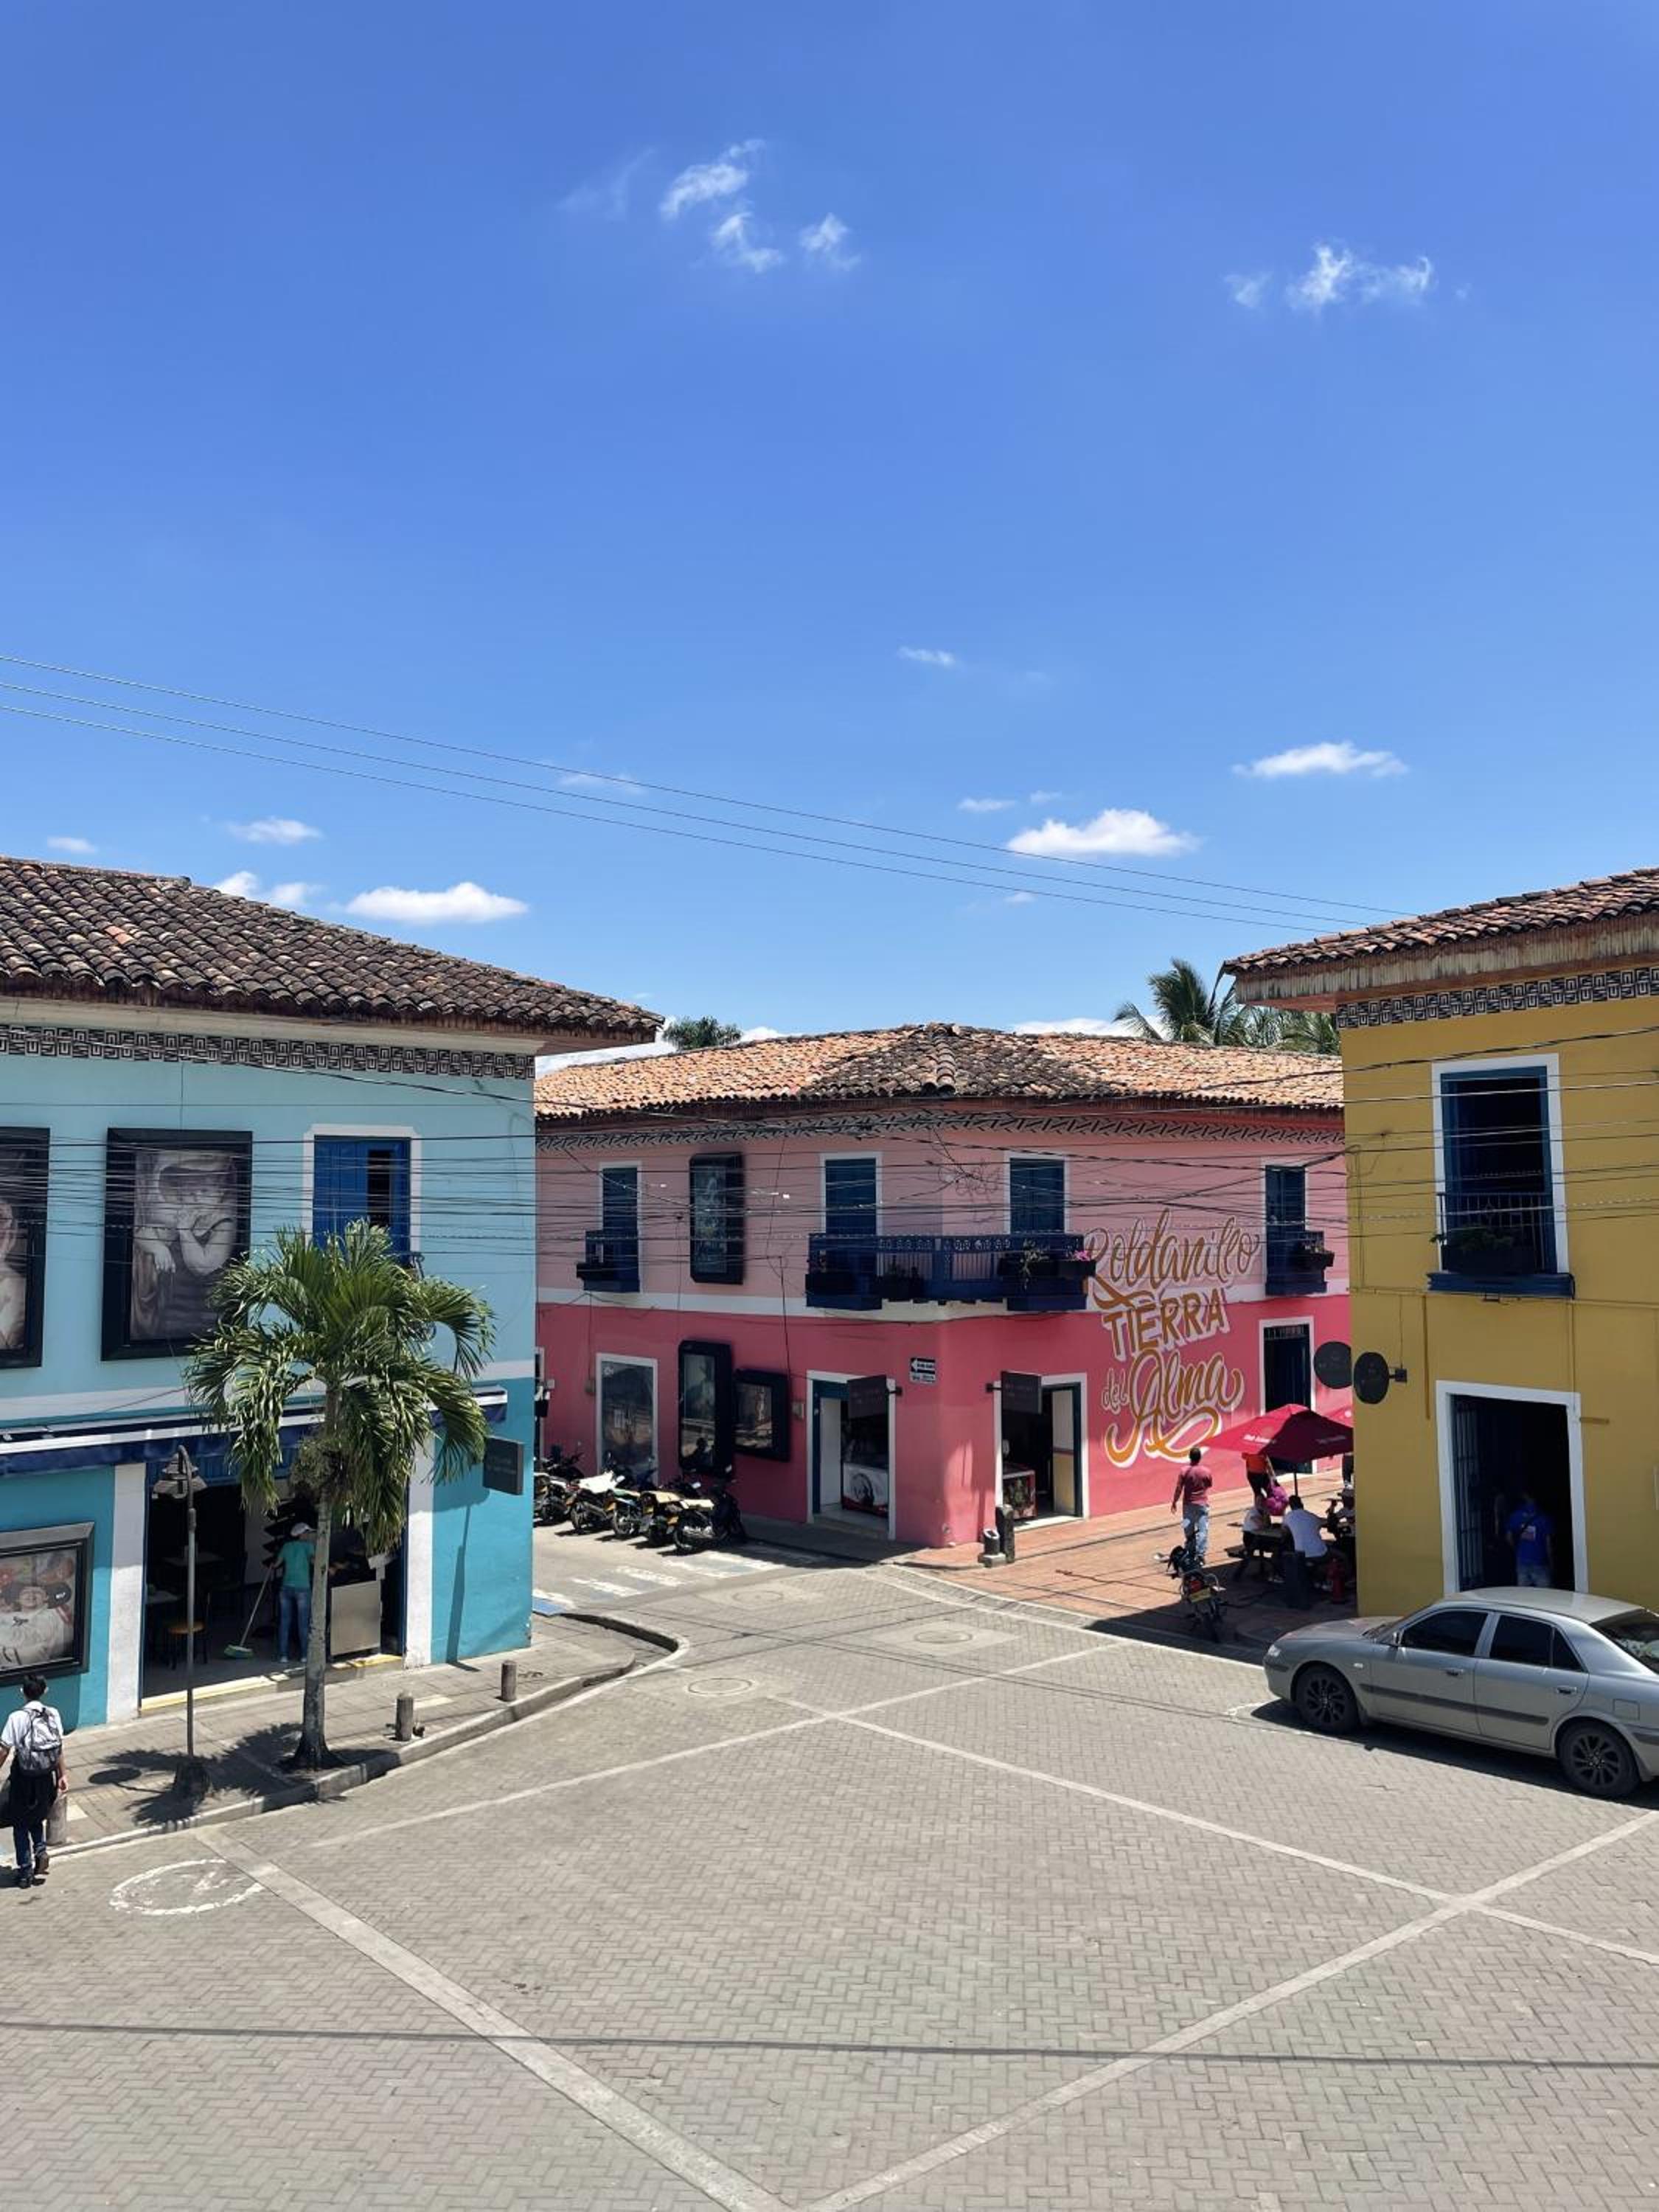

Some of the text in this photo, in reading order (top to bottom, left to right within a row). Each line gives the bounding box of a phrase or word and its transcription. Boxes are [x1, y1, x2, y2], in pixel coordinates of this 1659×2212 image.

[1085, 1208, 1260, 1308] Roldanillo
[1102, 1286, 1229, 1357] TIERRA
[1102, 1348, 1243, 1461] del Alma
